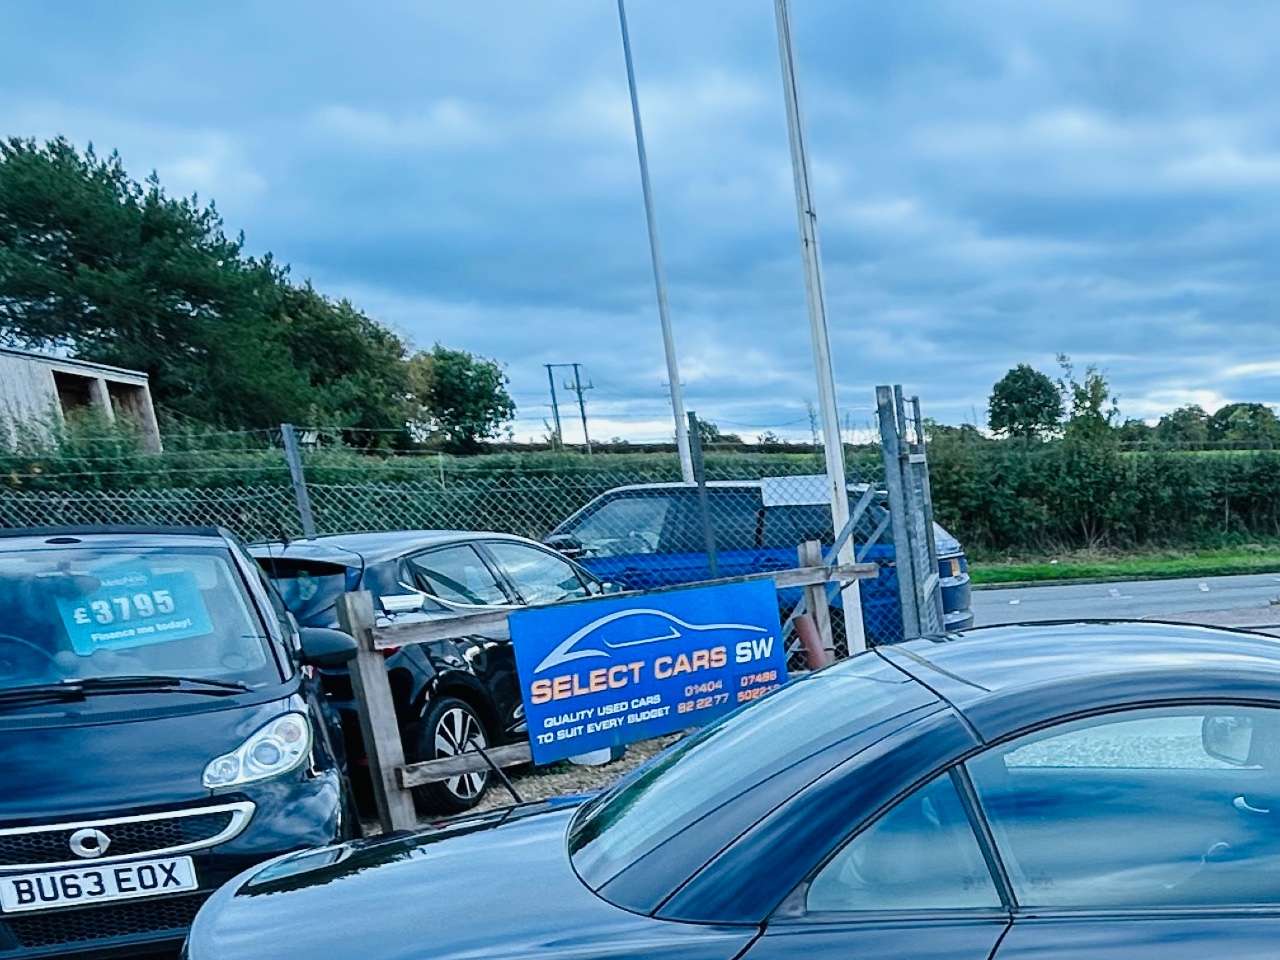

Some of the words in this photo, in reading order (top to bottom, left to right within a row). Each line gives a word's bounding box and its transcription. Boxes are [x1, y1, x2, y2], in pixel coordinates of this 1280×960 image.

[73, 590, 176, 625] £3795
[530, 661, 645, 704] SELECT
[654, 646, 727, 680] CARS
[735, 637, 774, 663] SW
[537, 733, 554, 745] TO
[556, 725, 584, 740] SUIT
[586, 716, 624, 733] EVERY
[627, 706, 671, 724] BUDGET
[544, 708, 594, 728] QUALITY
[597, 701, 628, 716] USED
[631, 694, 661, 709] CARS
[12, 872, 106, 904] BU63
[114, 862, 181, 893] EOX
